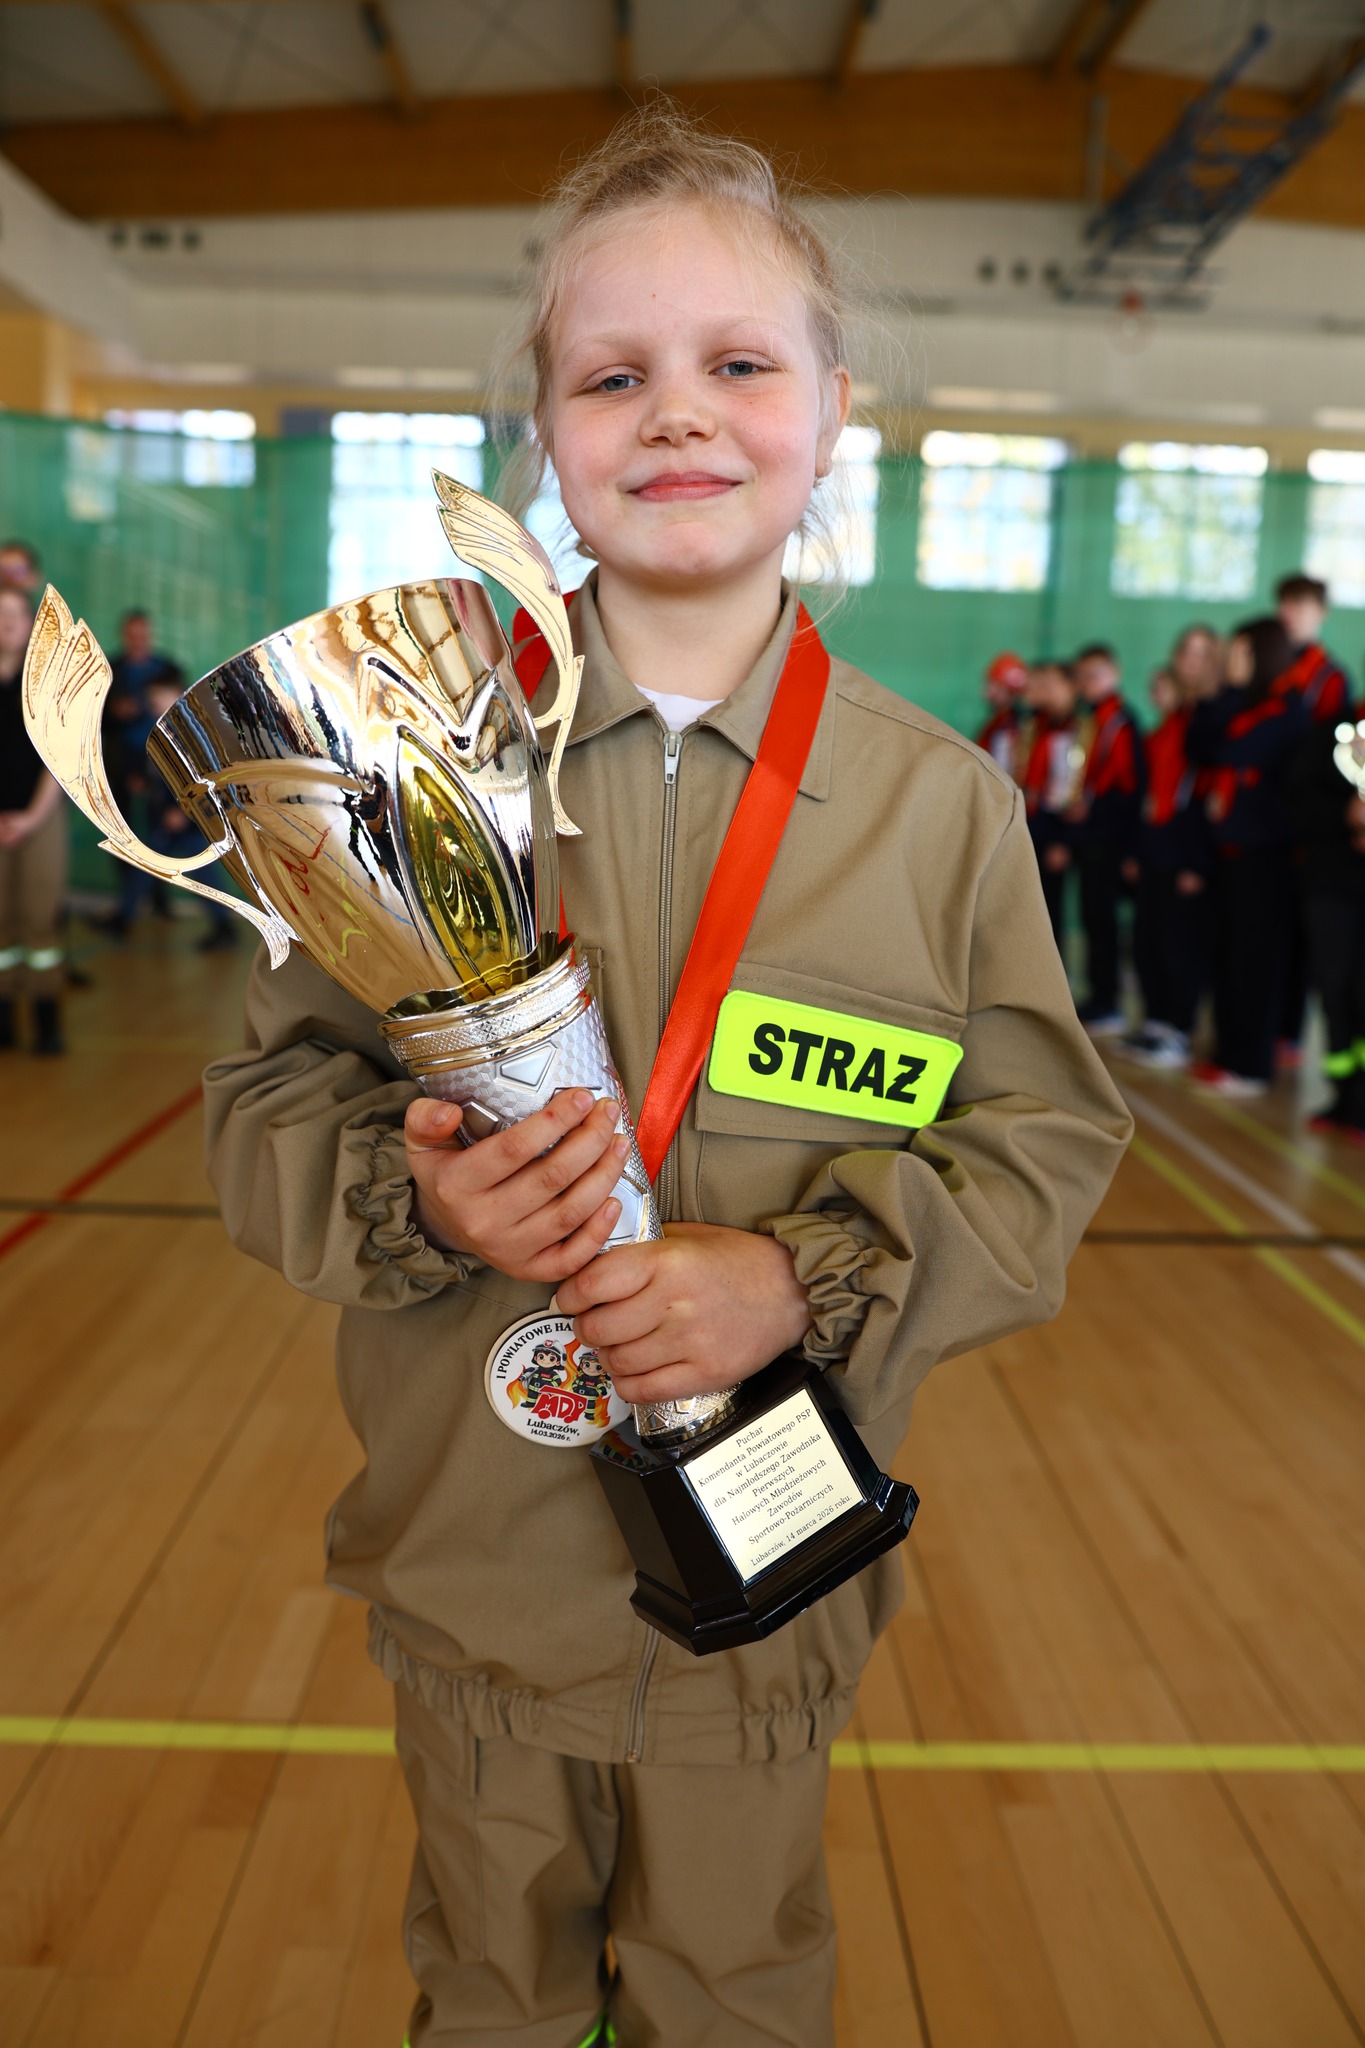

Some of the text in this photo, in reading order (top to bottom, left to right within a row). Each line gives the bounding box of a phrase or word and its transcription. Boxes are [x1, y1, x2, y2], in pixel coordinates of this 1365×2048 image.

[498, 1324, 553, 1374] POWIATOWE
[555, 1322, 574, 1332] HA
[531, 1391, 588, 1424] MDP
[527, 1418, 580, 1436] Lubaczów,
[531, 1428, 566, 1440] 14.03.2026
[735, 1426, 764, 1448] Puchar
[698, 1408, 811, 1487] Komendanta Powiatowego PSP
[735, 1440, 789, 1478] w Lubaczowie
[713, 1433, 821, 1508] dla Najmłodszego Zawodnika
[752, 1465, 796, 1497] Pierwszych
[731, 1458, 827, 1526] Halowych Młodzieżowych
[767, 1489, 803, 1517] Zawodów
[748, 1483, 834, 1545] Sportowo-Pożarniczych
[786, 1532, 796, 1542] 14
[796, 1518, 817, 1536] marca
[816, 1506, 834, 1521] 2026
[834, 1495, 852, 1509] roku.
